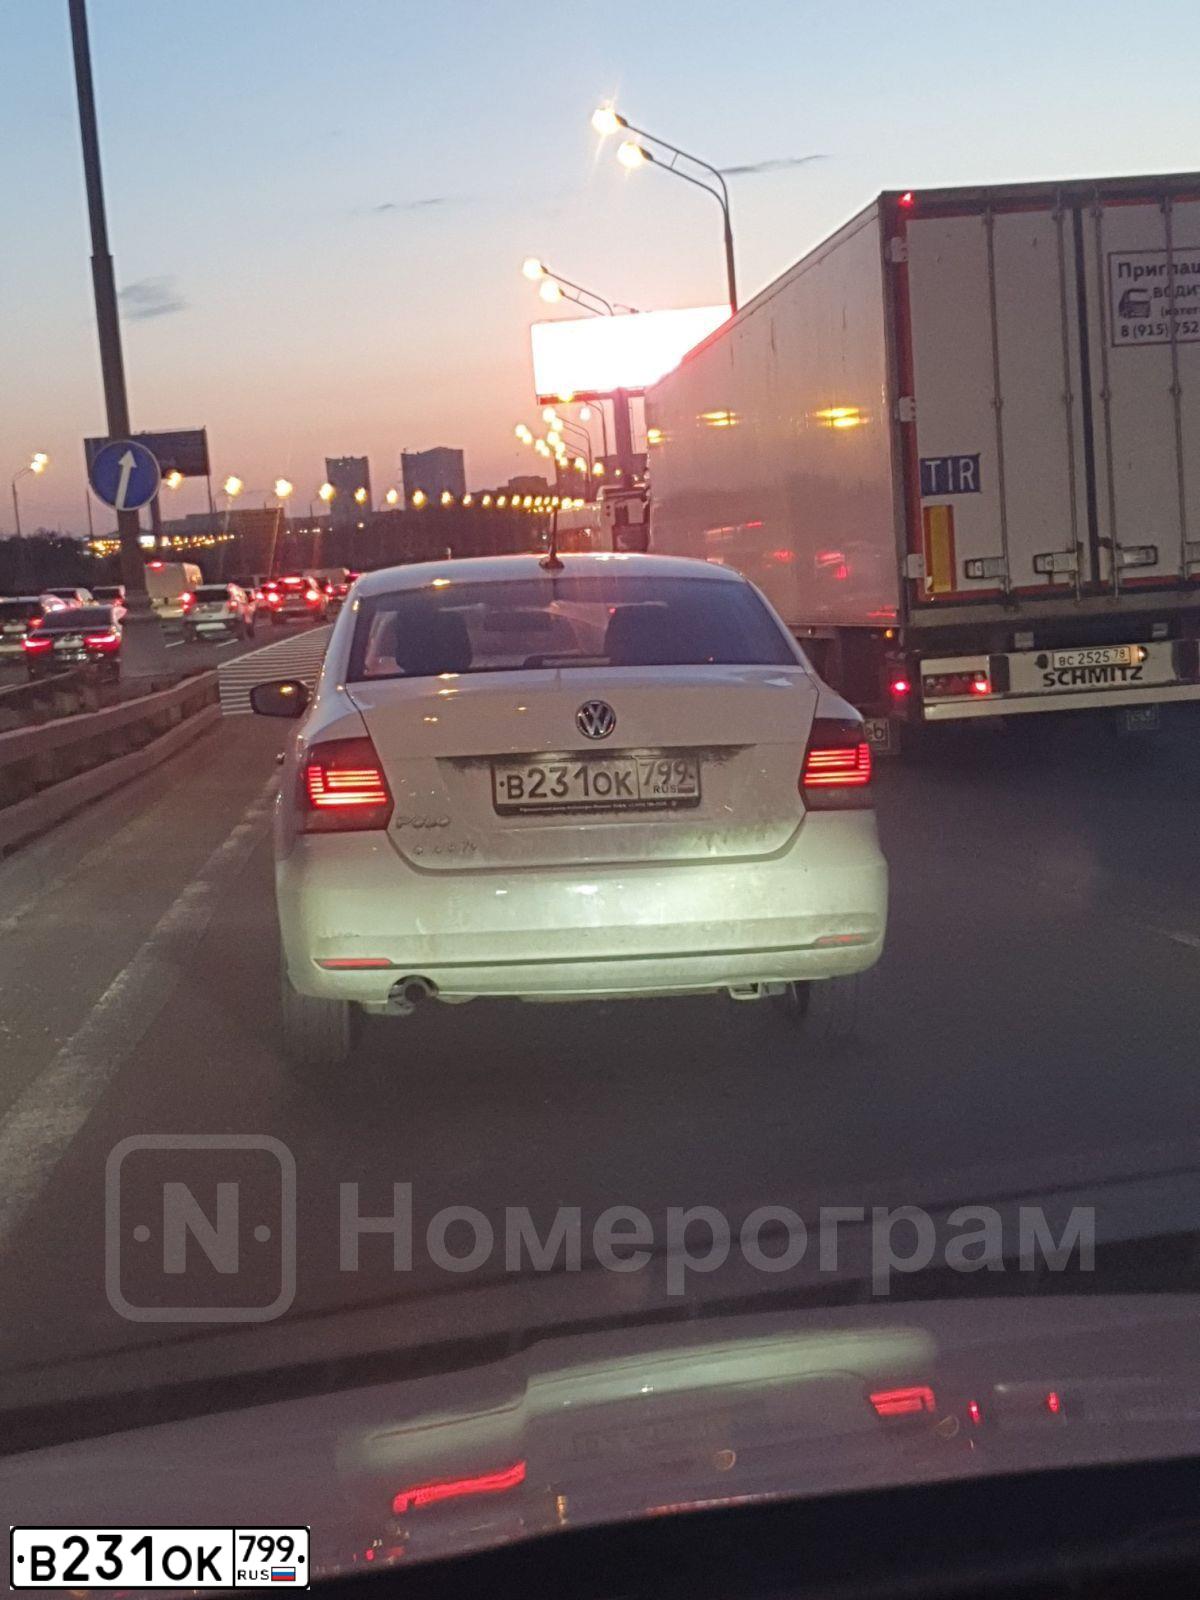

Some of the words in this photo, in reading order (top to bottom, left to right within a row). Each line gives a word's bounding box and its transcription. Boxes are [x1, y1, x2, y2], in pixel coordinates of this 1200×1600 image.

[1121, 325, 1129, 337] 8
[1133, 322, 1168, 339] (915)
[925, 459, 975, 492] TIR
[1078, 650, 1110, 664] 2525
[1043, 666, 1143, 687] SCHMITZ
[640, 759, 689, 786] 799
[653, 783, 676, 793] RUS
